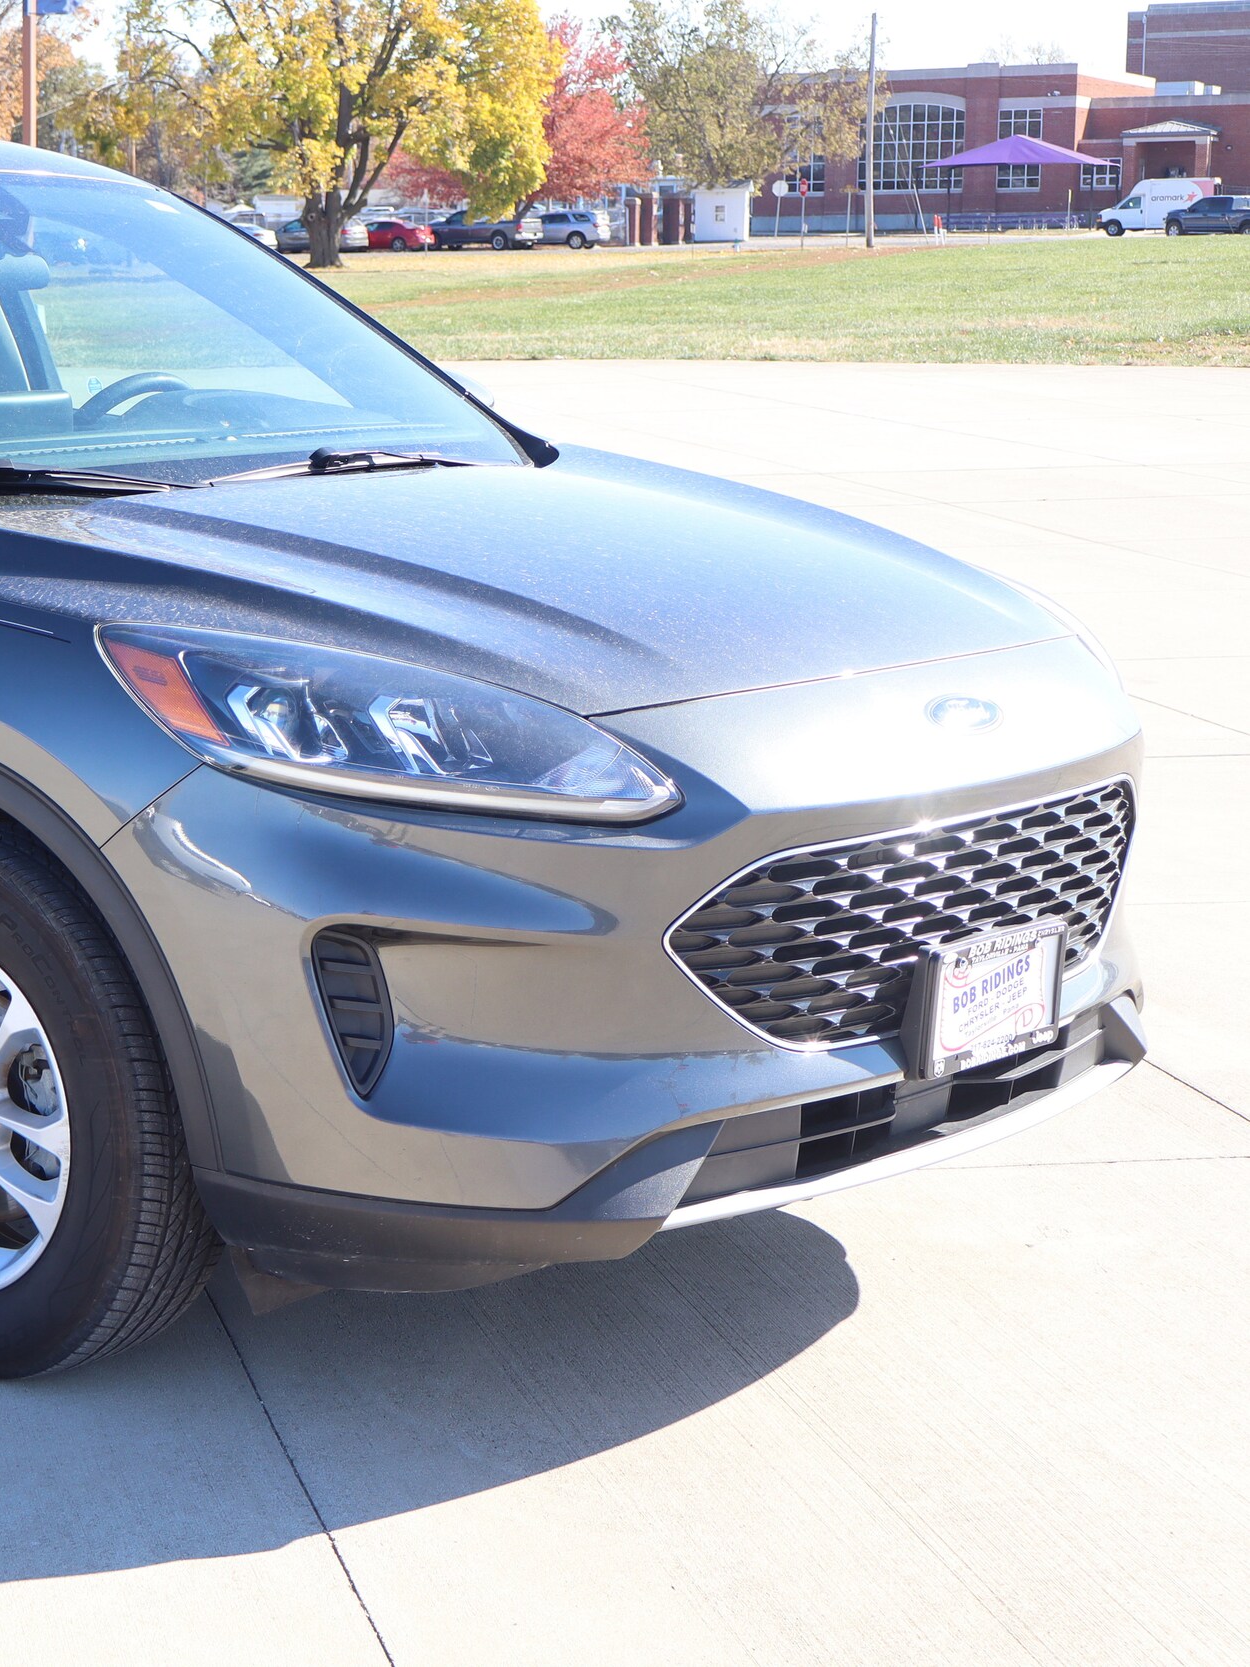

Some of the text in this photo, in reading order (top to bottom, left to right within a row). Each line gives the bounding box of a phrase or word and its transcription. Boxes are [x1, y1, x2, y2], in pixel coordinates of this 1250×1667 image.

[1151, 194, 1184, 202] aramark
[967, 930, 1037, 959] BOB RIDINGS
[953, 954, 1031, 1014] BOB RIDINGS
[967, 998, 989, 1016] FORD
[996, 977, 1025, 999] DODGE
[958, 1002, 1000, 1032] CHRYSLER
[1007, 986, 1028, 1004] JEEP
[1032, 1030, 1054, 1045] Jeep
